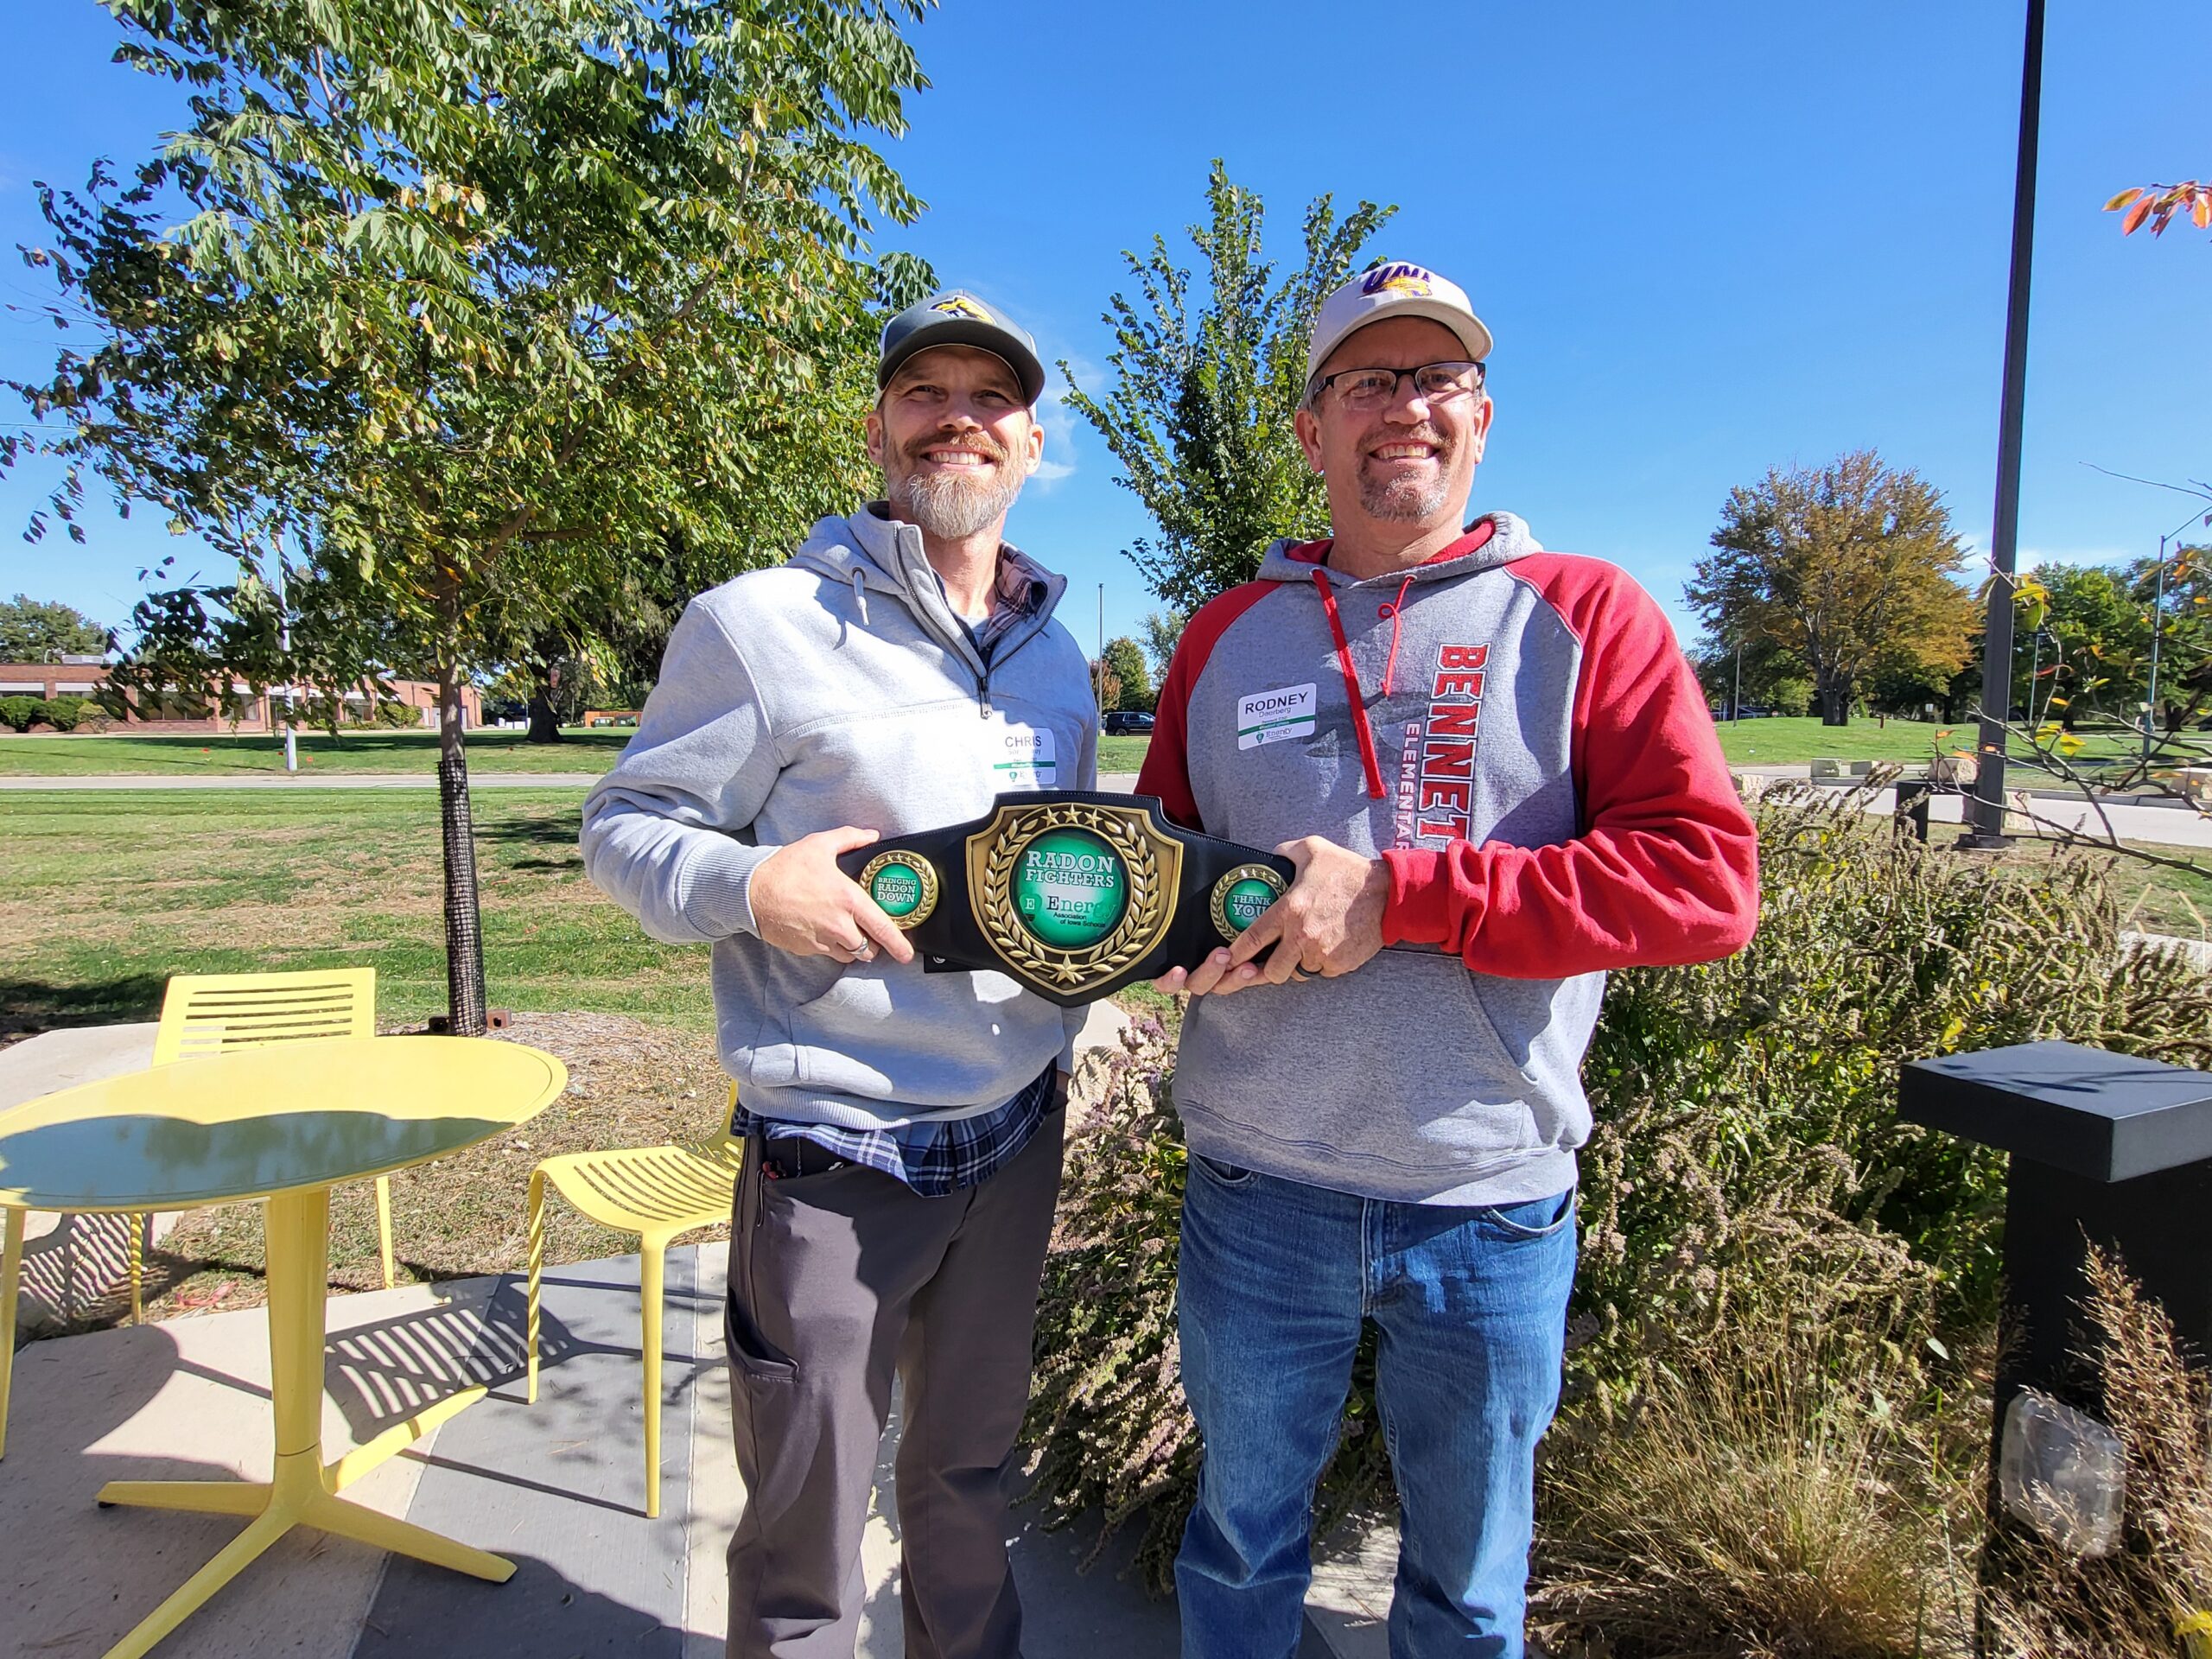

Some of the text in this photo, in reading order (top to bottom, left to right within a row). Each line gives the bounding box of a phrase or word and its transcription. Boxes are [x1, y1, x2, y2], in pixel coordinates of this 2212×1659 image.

[1245, 692, 1307, 715] RODNEY
[1005, 736, 1042, 747] CHRIS
[1026, 850, 1116, 874] RADON
[877, 876, 917, 886] BRINGING
[1025, 868, 1115, 888] FIGHTERS
[877, 883, 916, 893] RADON
[877, 891, 916, 903] DOWN
[1232, 894, 1272, 906] THANK
[1053, 912, 1087, 920] Association
[1232, 904, 1267, 918] YOU
